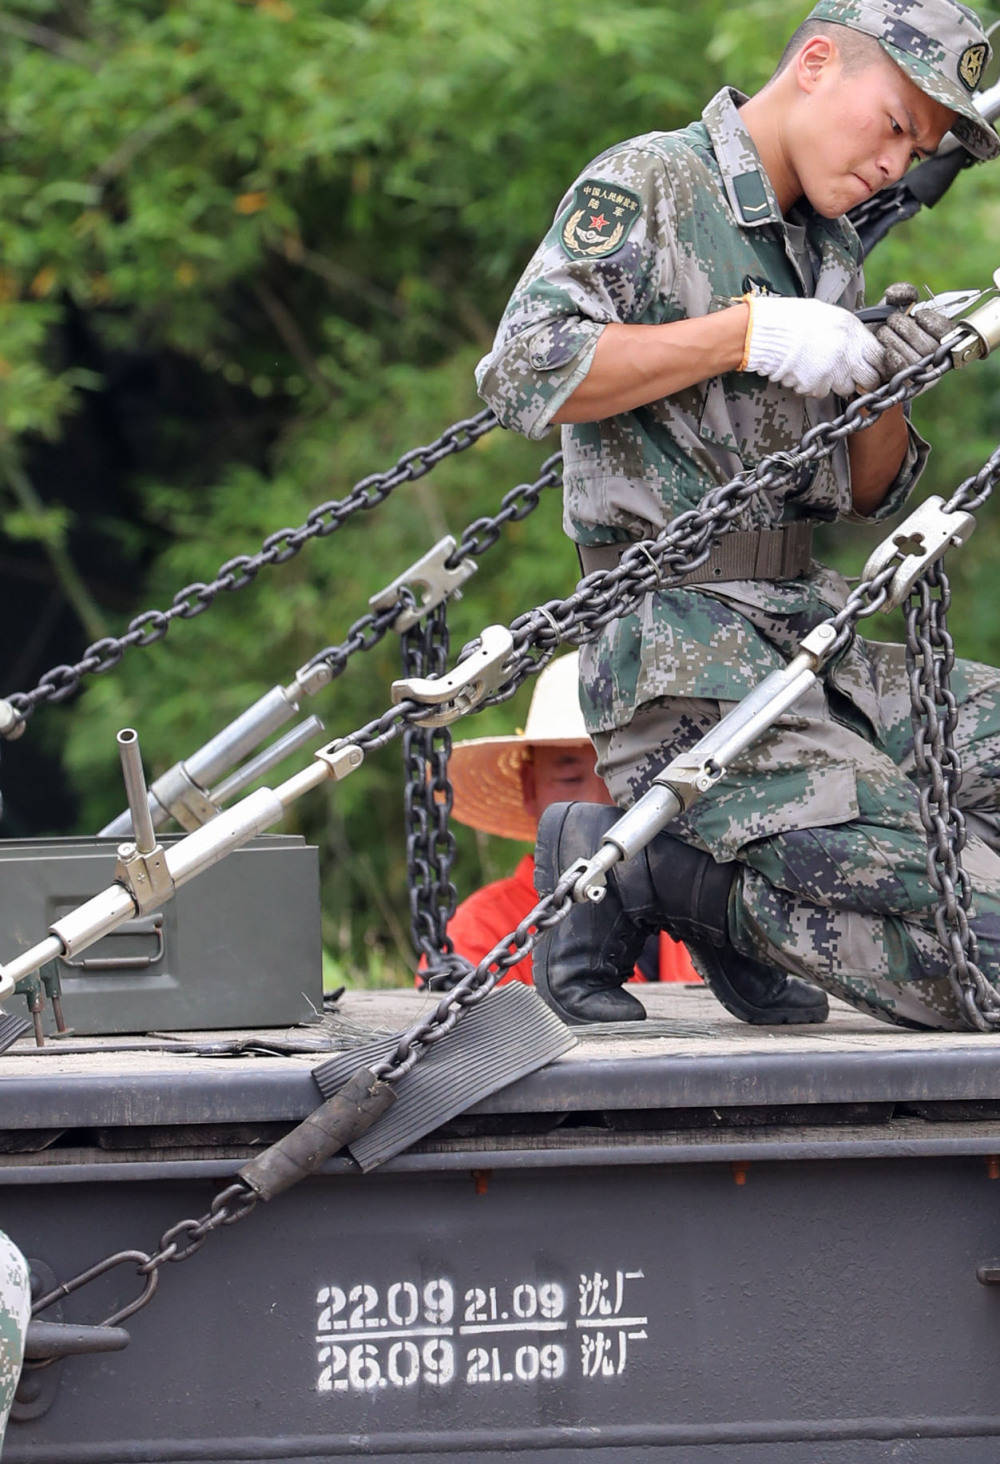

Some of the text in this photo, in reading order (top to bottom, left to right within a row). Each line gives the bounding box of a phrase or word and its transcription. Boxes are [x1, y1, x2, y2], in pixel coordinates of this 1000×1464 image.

[583, 185, 639, 211] 中国人民解放军
[316, 1269, 645, 1332] 22.09 21.09 沈厂
[317, 1329, 648, 1393] 26.09 21.09 沈厂
